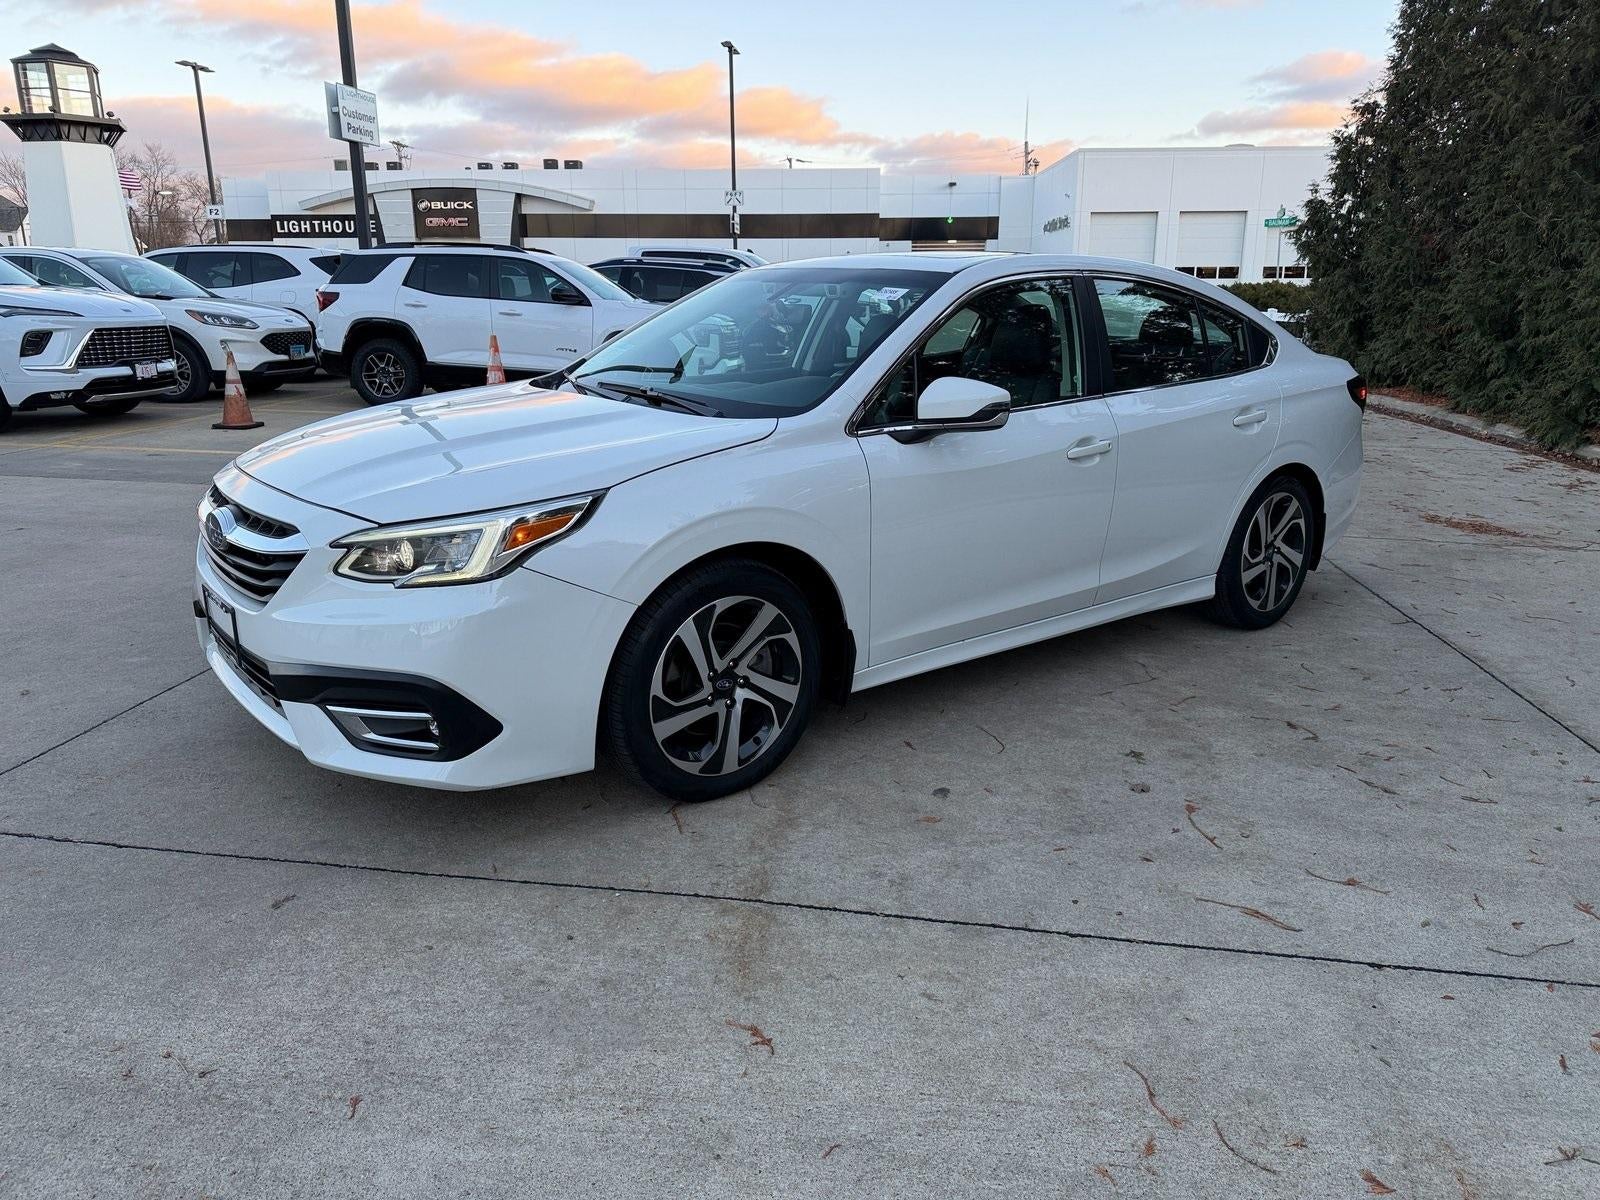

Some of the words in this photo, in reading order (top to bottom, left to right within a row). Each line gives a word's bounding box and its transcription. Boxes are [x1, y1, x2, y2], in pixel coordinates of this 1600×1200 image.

[342, 106, 376, 124] Customer
[347, 122, 374, 141] Parking
[430, 201, 474, 209] BUICK
[209, 208, 220, 216] F2
[276, 220, 377, 234] LIGHTHOUE
[425, 217, 469, 227] GMC
